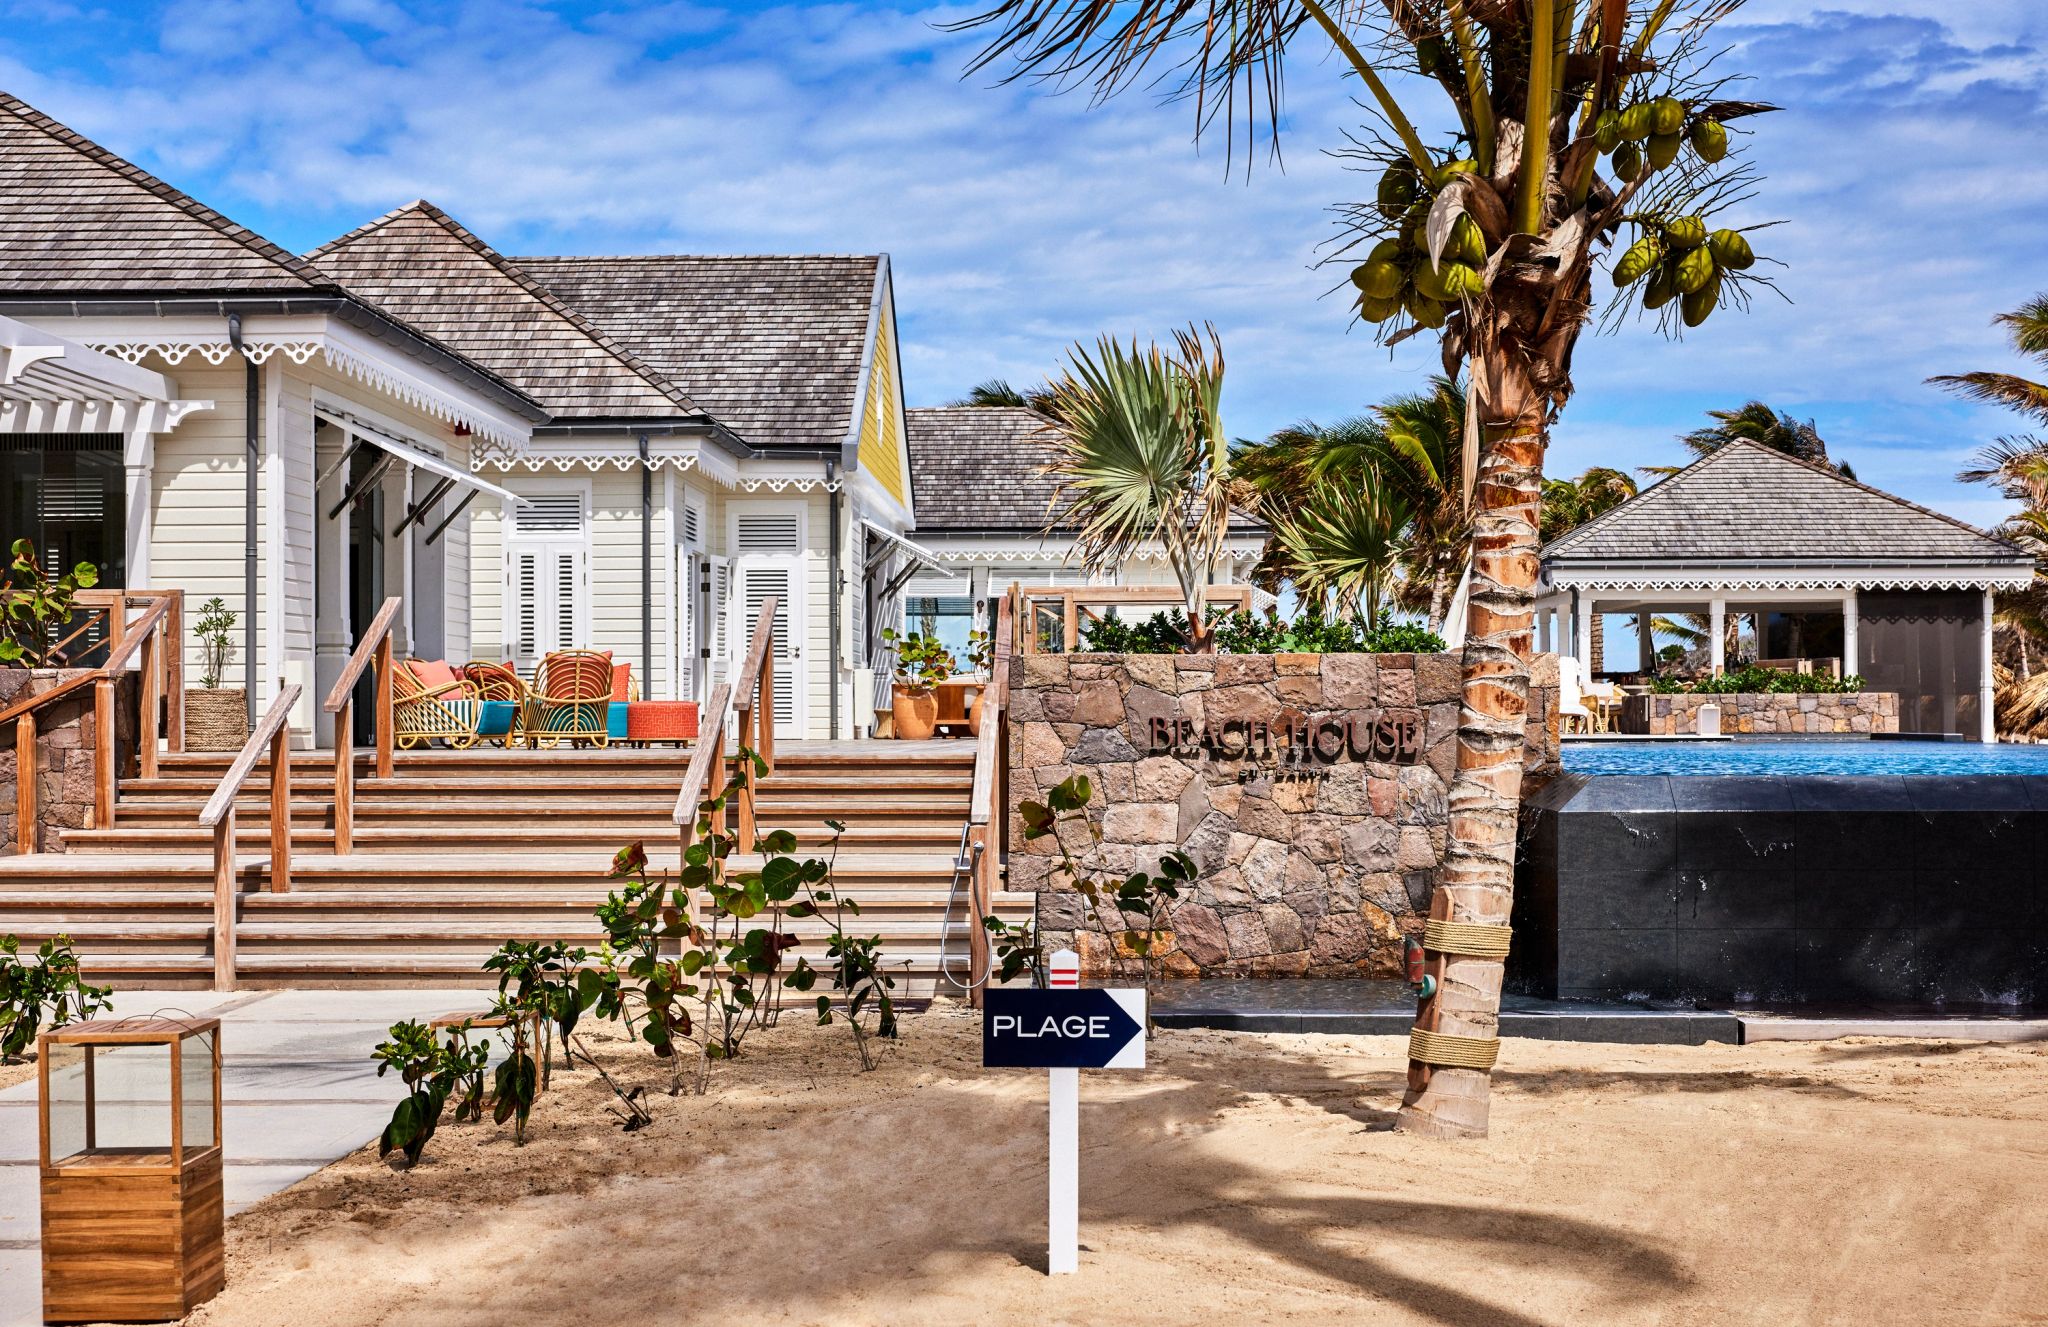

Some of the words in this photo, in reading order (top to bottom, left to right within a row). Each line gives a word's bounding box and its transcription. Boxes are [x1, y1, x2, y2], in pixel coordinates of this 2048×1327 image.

[1147, 715, 1273, 750] BEACH
[1287, 714, 1417, 749] HOUSE
[993, 1015, 1110, 1038] PLAGE
